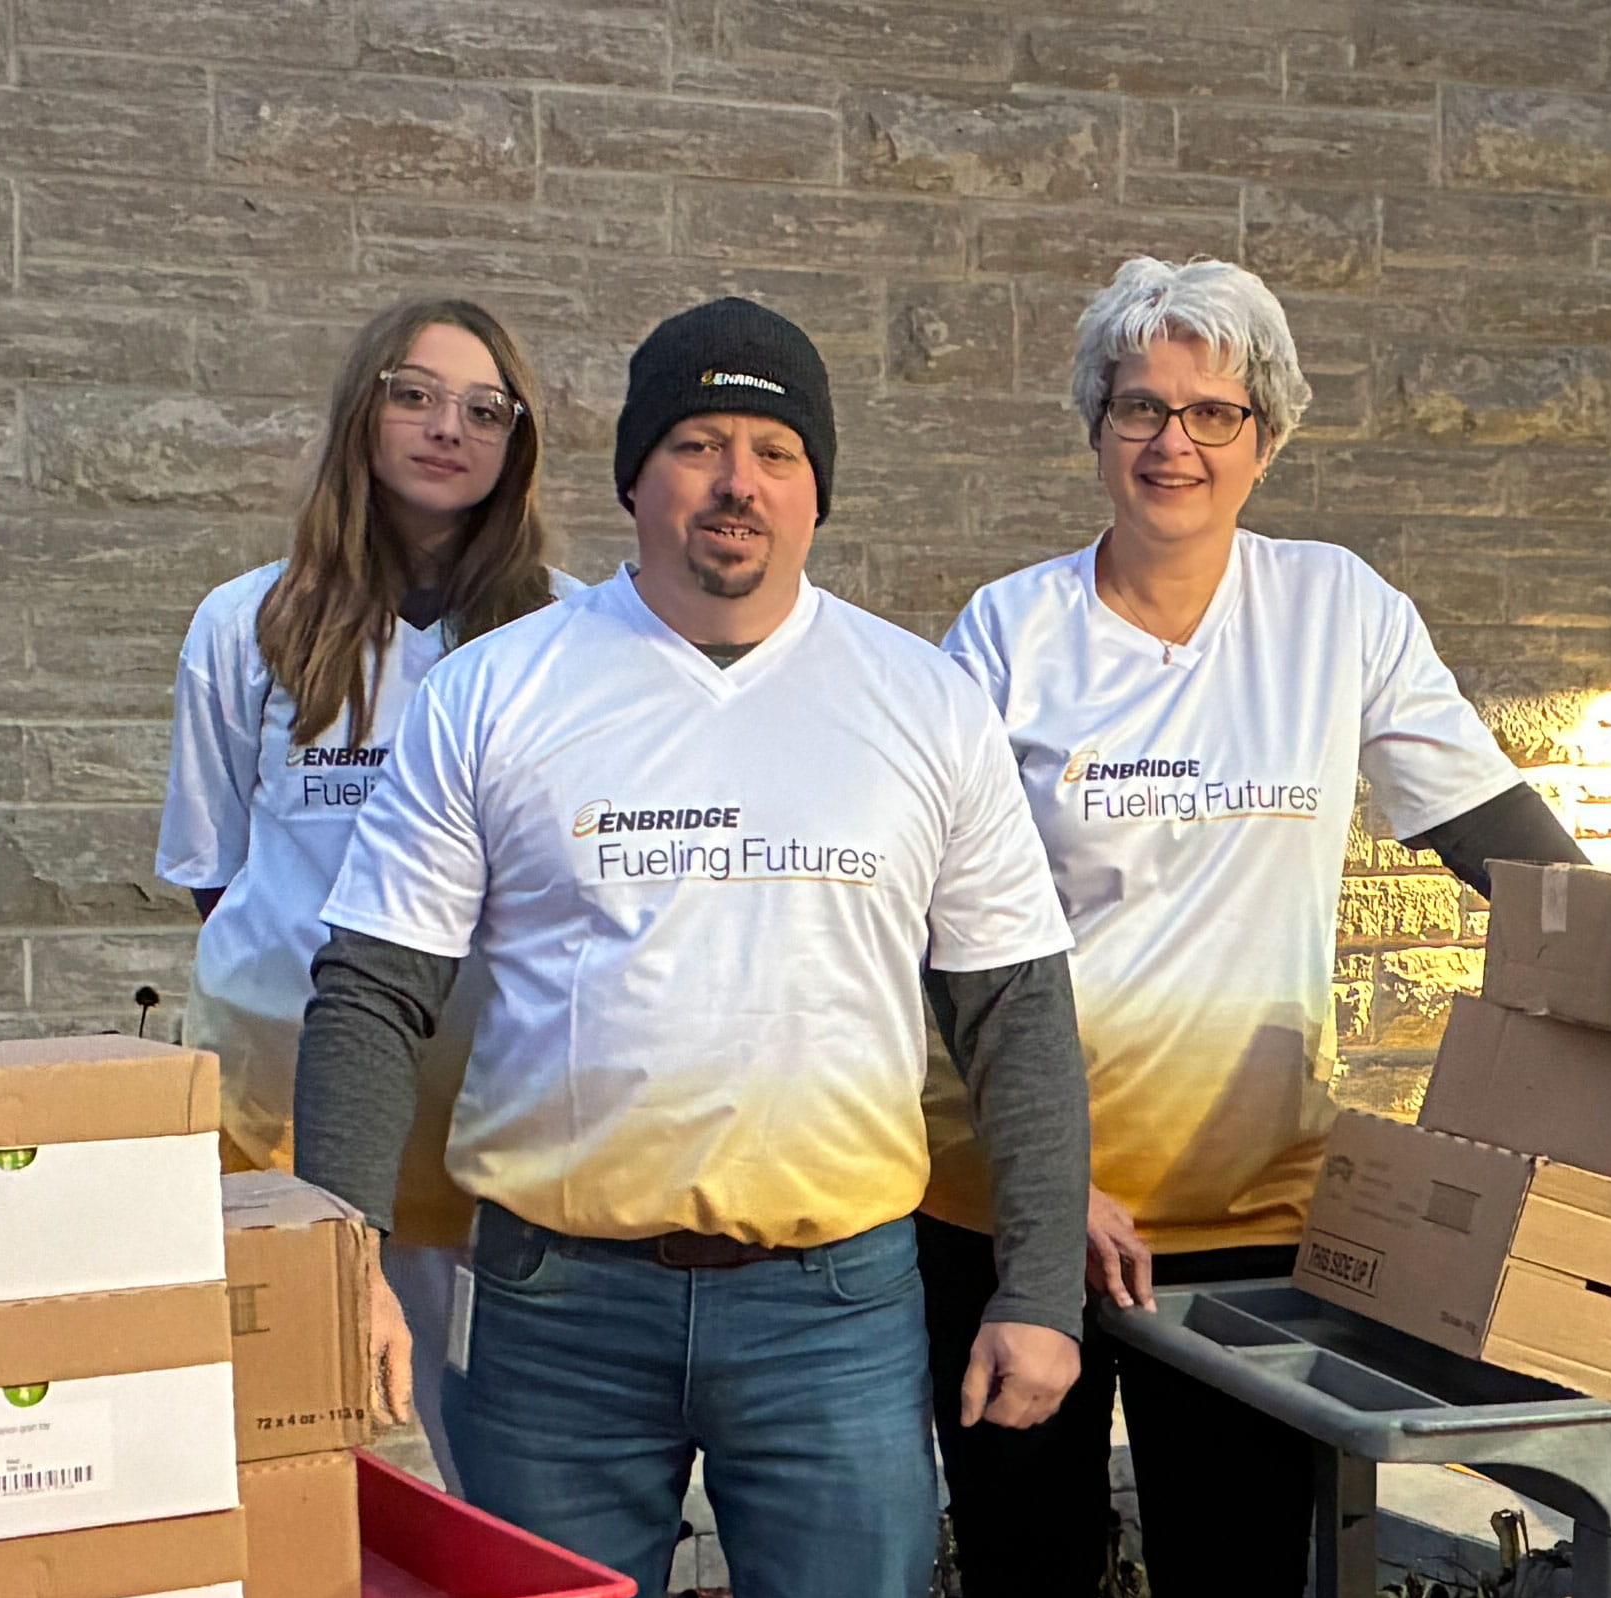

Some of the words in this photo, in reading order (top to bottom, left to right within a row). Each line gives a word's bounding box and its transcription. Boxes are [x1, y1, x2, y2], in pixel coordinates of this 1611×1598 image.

[1085, 759, 1201, 782] ENBRIDGE
[1084, 785, 1196, 822] Fueling
[1205, 780, 1318, 812] Futures
[598, 807, 741, 835] ENBRIDGE
[598, 840, 731, 881] Fueling
[742, 838, 877, 878] Futures
[256, 1417, 272, 1430] 72
[288, 1414, 296, 1425] 4
